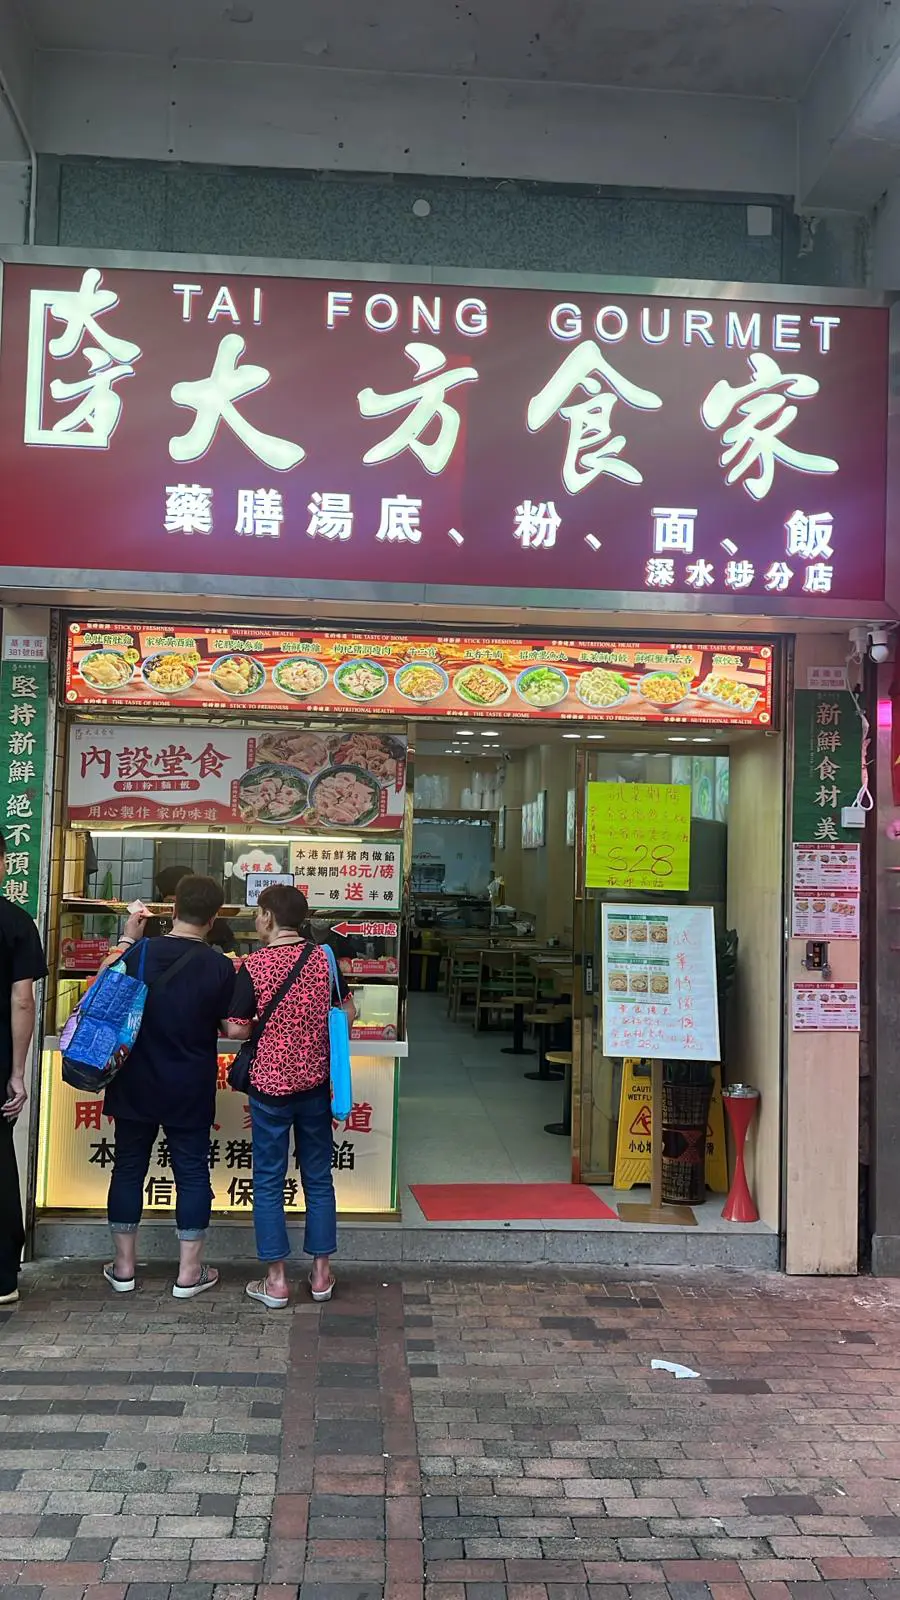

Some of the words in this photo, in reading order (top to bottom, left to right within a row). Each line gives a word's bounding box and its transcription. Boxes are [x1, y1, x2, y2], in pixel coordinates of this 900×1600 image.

[173, 284, 262, 324] TAI
[326, 291, 488, 336] FONG
[549, 302, 841, 353] GOURMET
[168, 333, 840, 500] 大方食家
[813, 703, 842, 841] 新鮮食材美
[156, 807, 219, 820] 家的味道
[361, 923, 396, 936] 收銀處
